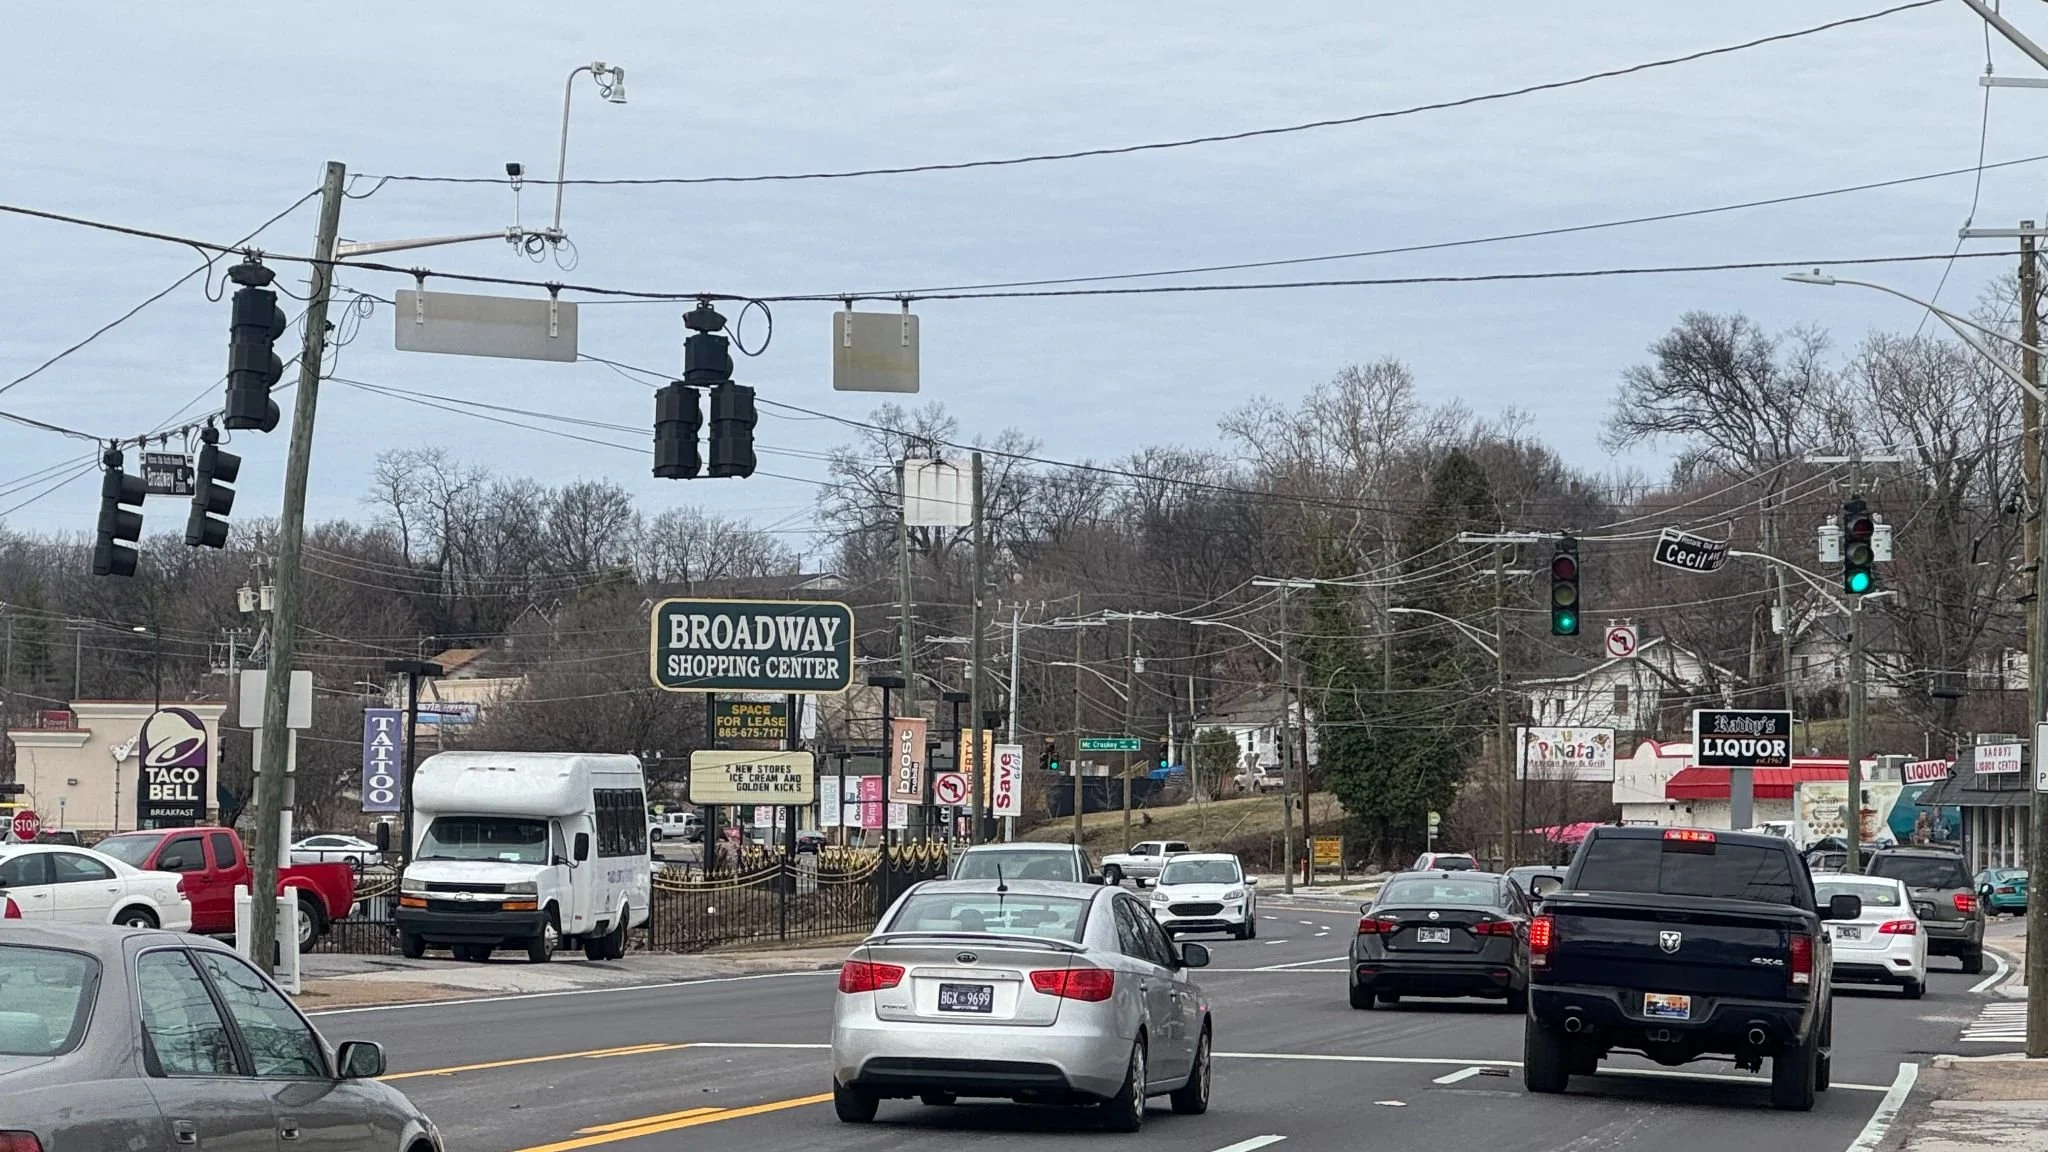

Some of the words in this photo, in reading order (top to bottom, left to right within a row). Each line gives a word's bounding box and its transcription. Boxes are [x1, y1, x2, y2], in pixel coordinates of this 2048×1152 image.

[147, 466, 174, 492] Broadway
[1666, 544, 1707, 568] Cecil
[668, 614, 841, 652] BROADWAY
[668, 654, 760, 677] SHOPPING
[765, 657, 839, 679] CENTER
[731, 705, 771, 715] SPACE
[717, 716, 740, 726] FOR
[748, 717, 786, 726] LEASE
[1713, 714, 1776, 736] Raddy's
[718, 728, 784, 738] 865-675-7171
[1702, 739, 1786, 757] LIQUOR
[369, 717, 394, 803] TATTOO
[896, 729, 913, 793] boost
[1588, 760, 1605, 768] Grill
[1998, 760, 2018, 770] CENTER
[145, 767, 200, 784] TACO
[725, 765, 731, 773] 2
[736, 765, 753, 773] NEW
[757, 765, 791, 774] STORES
[911, 762, 919, 794] mobile
[1906, 762, 1946, 780] LIQUOR
[729, 774, 743, 782] ICE
[749, 774, 778, 782] CREAM
[784, 774, 802, 783] AND
[867, 781, 876, 792] 10
[996, 753, 1012, 809] Save
[149, 784, 199, 800] BELL
[736, 783, 770, 792] GOLDEN
[774, 783, 802, 792] KICKS
[867, 793, 878, 824] Simpy
[14, 819, 39, 832] STOP
[941, 991, 958, 1005] BGX
[967, 992, 990, 1006] 9699
